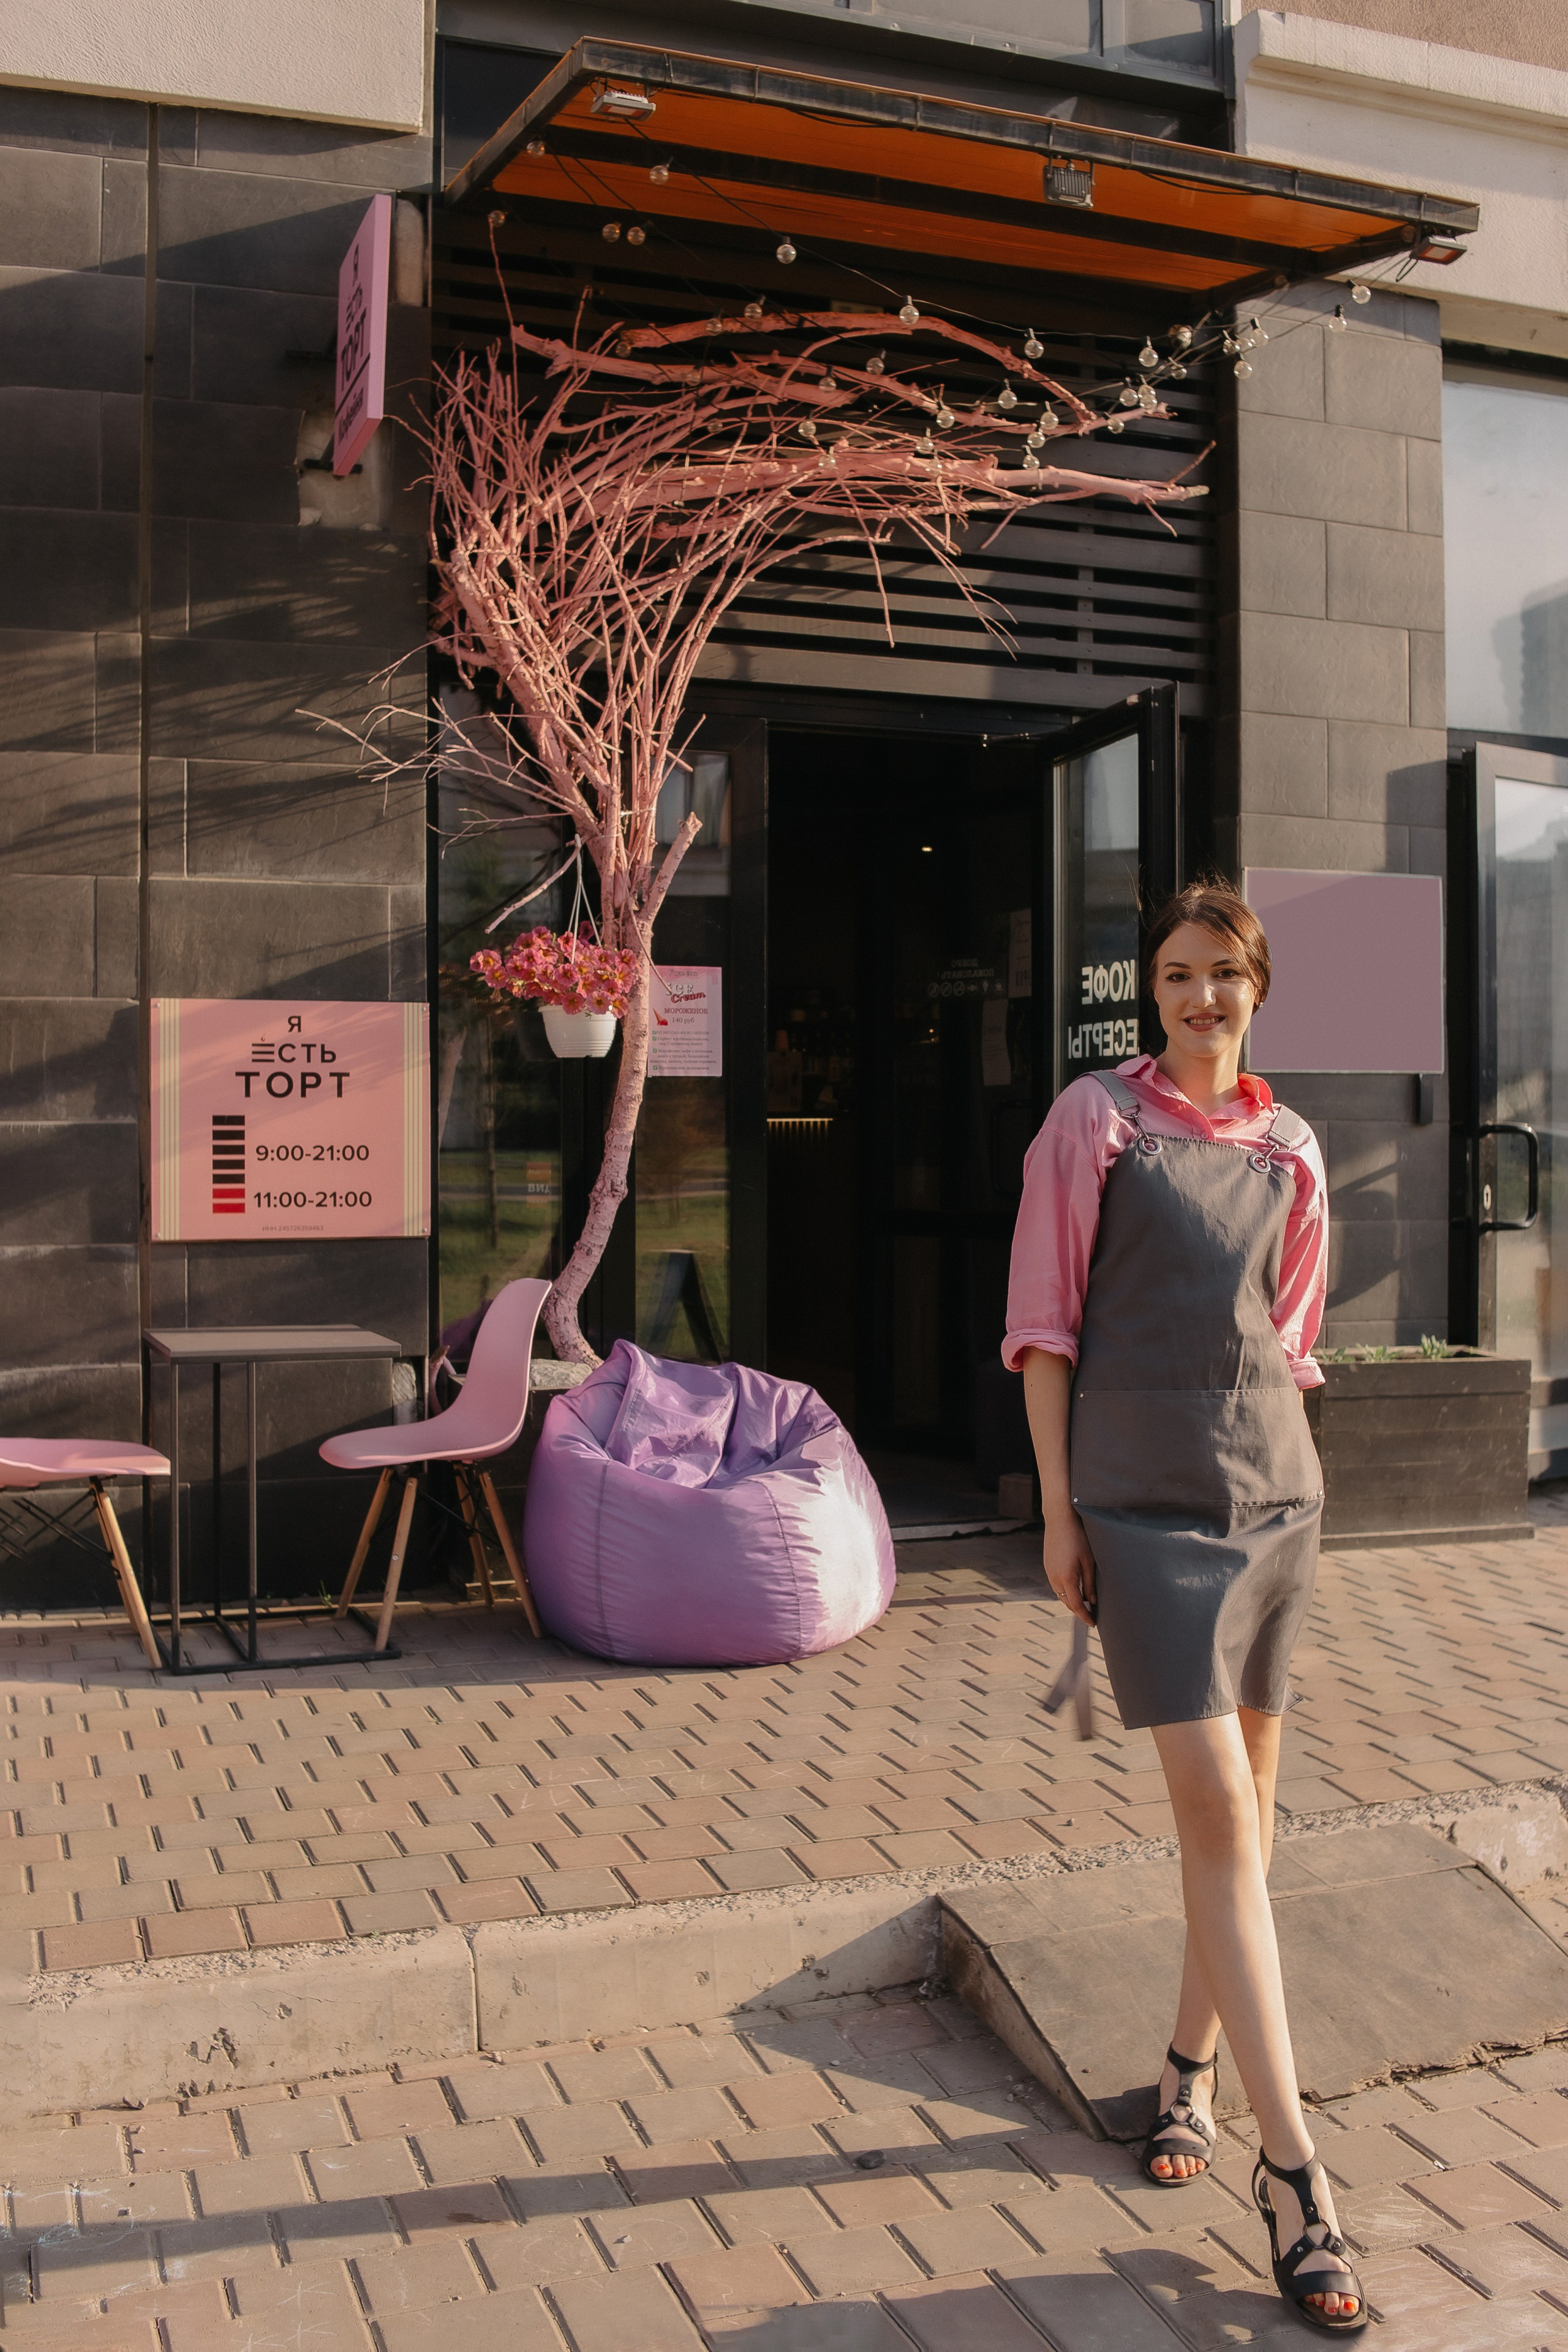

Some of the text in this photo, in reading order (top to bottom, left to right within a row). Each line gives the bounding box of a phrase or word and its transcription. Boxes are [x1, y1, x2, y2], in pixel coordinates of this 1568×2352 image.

[352, 243, 359, 286] Я
[341, 307, 366, 392] ТОРТ
[670, 992, 706, 1003] Cream
[287, 1016, 302, 1033] Я
[235, 1071, 350, 1098] ТОРТ
[255, 1144, 369, 1161] 9:00-21:00
[254, 1191, 372, 1208] 11:00-21:00
